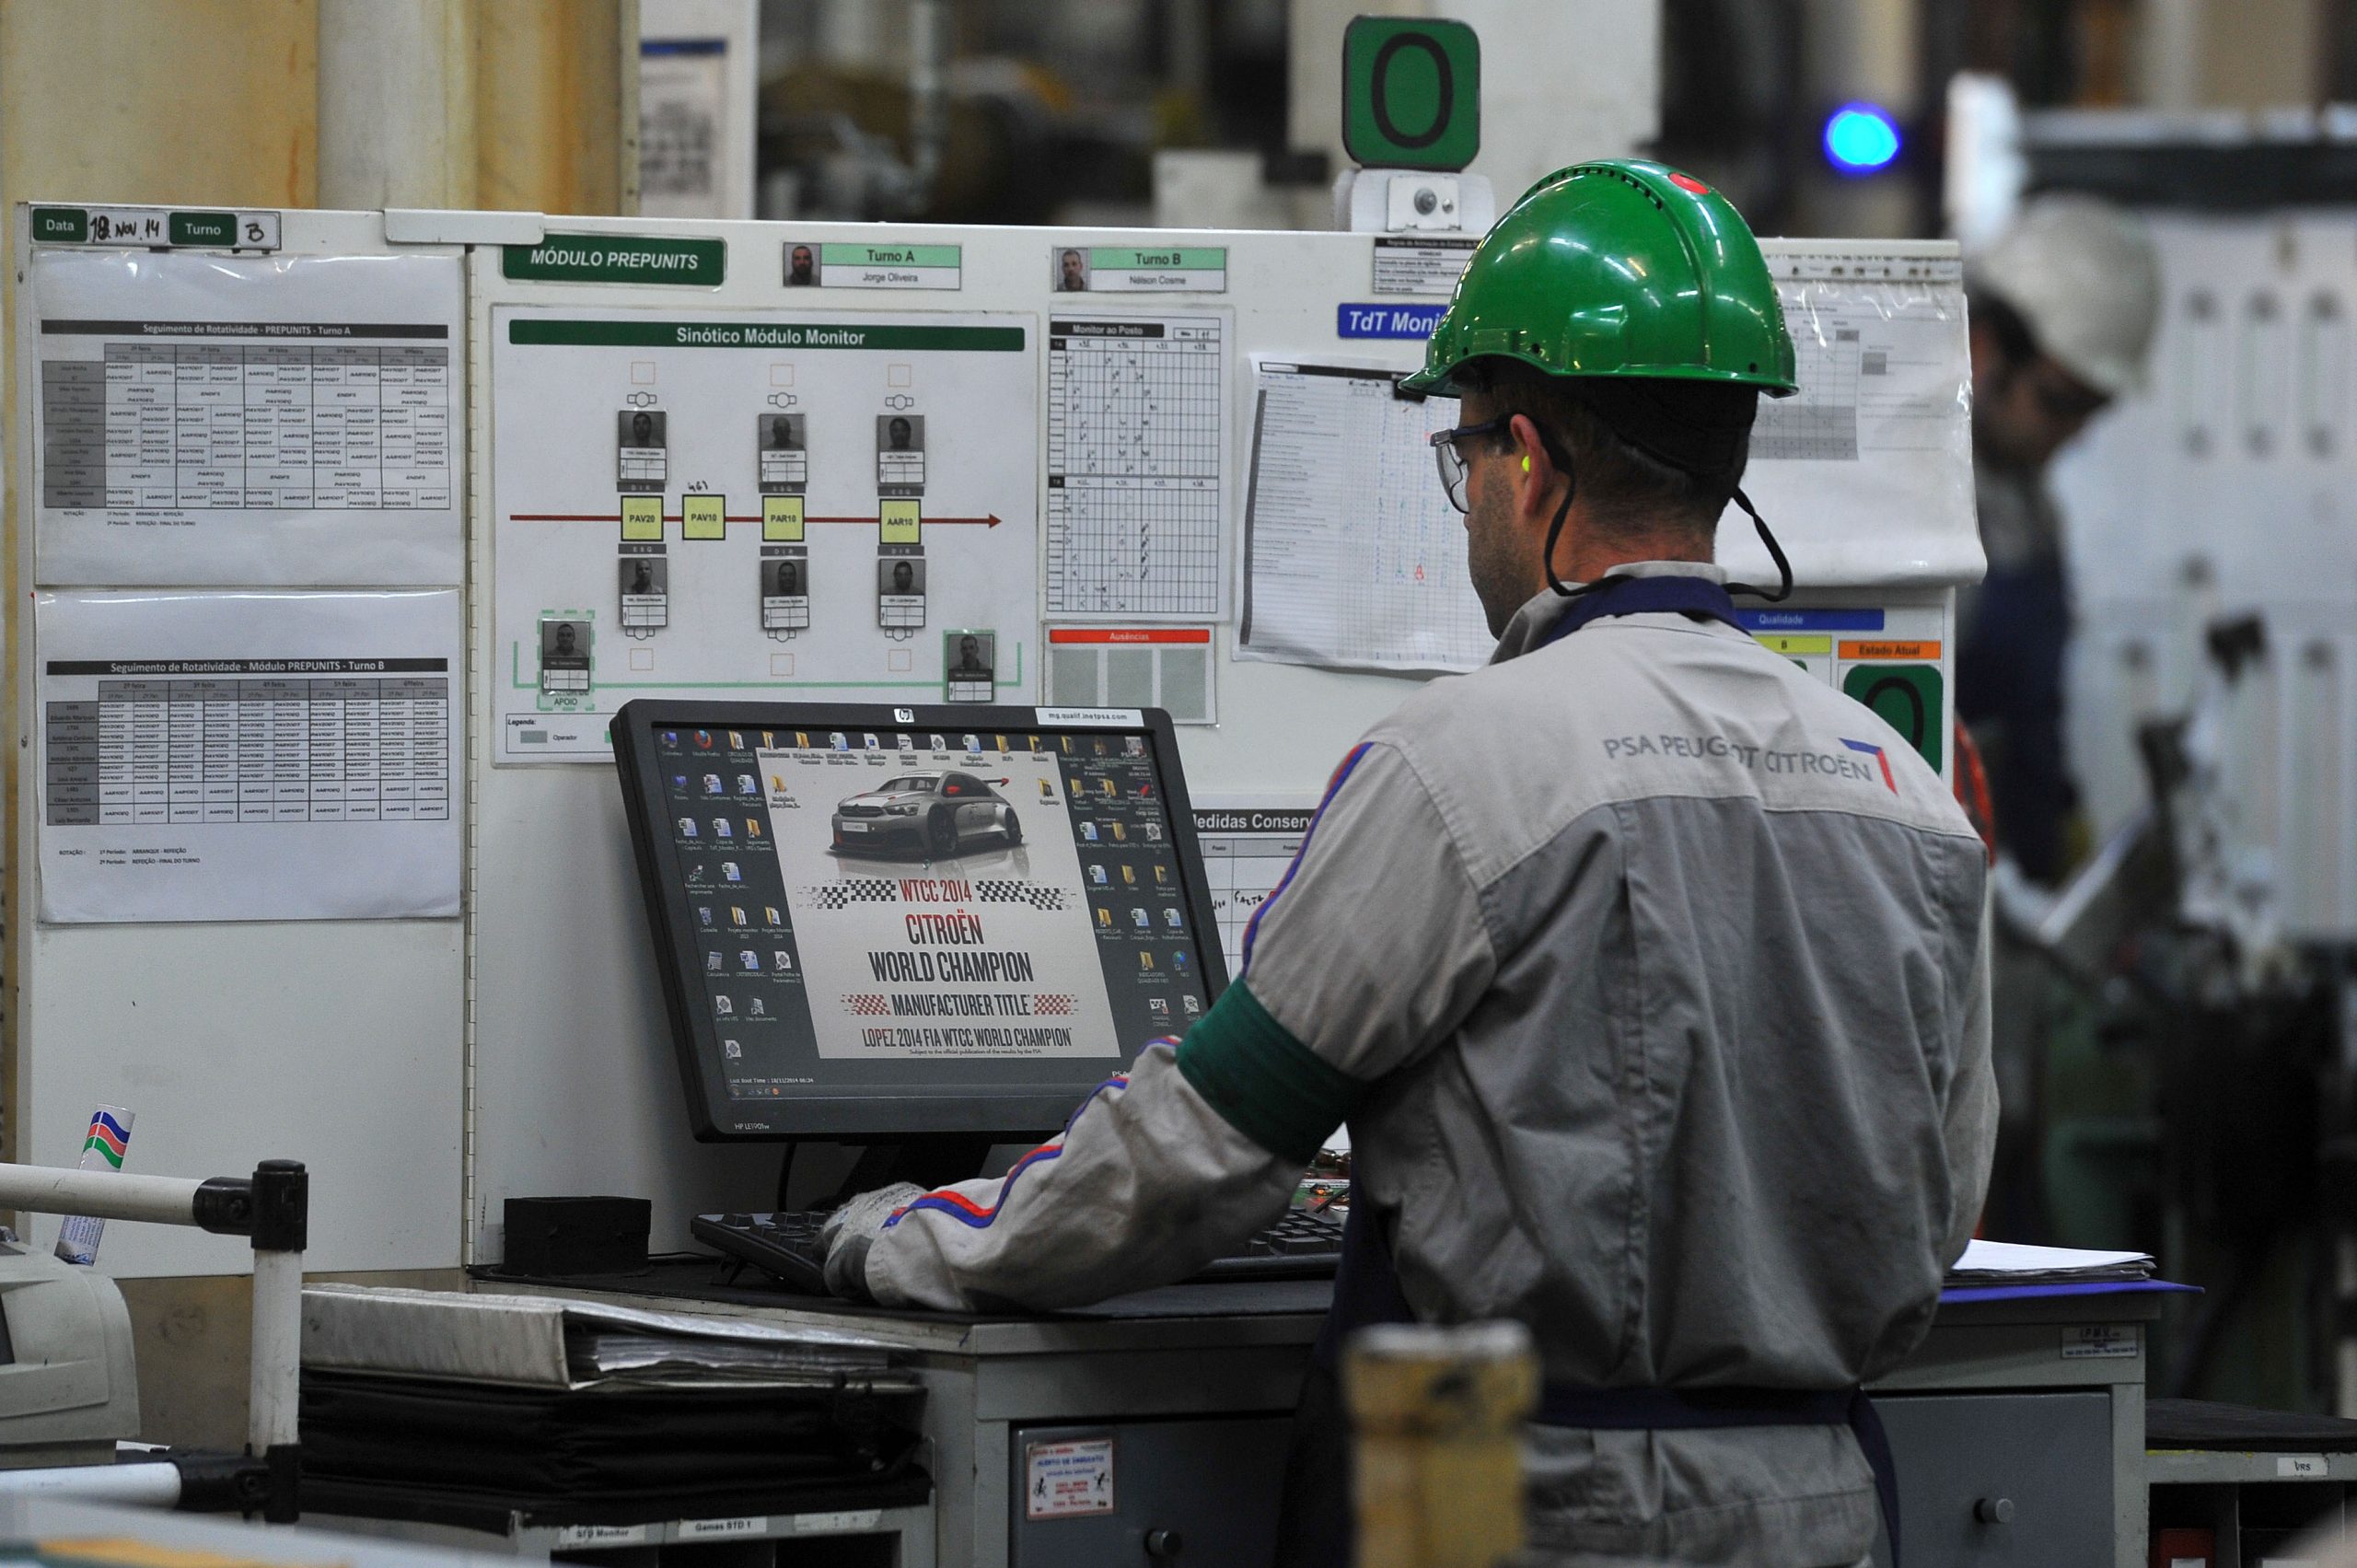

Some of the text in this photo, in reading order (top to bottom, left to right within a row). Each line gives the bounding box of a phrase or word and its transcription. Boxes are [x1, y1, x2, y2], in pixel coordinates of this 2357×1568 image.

[45, 217, 75, 232] Data
[145, 217, 160, 238] 14
[185, 222, 222, 237] Turno
[530, 246, 699, 271] MÓDULO PREPUNITS
[866, 249, 915, 263] Turno A
[1135, 253, 1181, 266] Turno B
[862, 273, 918, 284] Jorge Oliveira
[1158, 275, 1187, 286] Cosme
[1349, 310, 1439, 332] TdT Moni
[143, 323, 352, 335] Seguimento de Rotatividade PREPUNITS Turno A
[1073, 325, 1105, 335] Monitor
[1120, 326, 1144, 335] Posto
[676, 326, 865, 346] Sinótico Módulo Monitor
[629, 514, 656, 524] PAV20
[691, 513, 717, 523] PAV10
[770, 514, 796, 524] PAR10
[887, 517, 913, 527] AAR10
[1758, 613, 1804, 626] Qualidade
[1109, 632, 1149, 642] Ausências
[1859, 644, 1921, 656] Estado Atual
[110, 661, 385, 674] Seguimento de Rotatividade Módulo PREPUNITS Turno B
[553, 697, 578, 707] APOIO
[507, 718, 537, 727] Legenda:
[552, 733, 577, 742] Operador
[1602, 735, 1873, 782] PSA PEUGT CITROËN
[1191, 813, 1313, 829] edidas Conserv
[899, 879, 973, 902] WTCC 2014
[905, 910, 984, 945] CITROËN
[867, 951, 1034, 982] WORLD CHAMPION
[890, 993, 993, 1016] MANUFACTURER
[862, 1028, 896, 1048] LOPEZ
[897, 1028, 923, 1047] 2014
[924, 1028, 942, 1047] FIA
[942, 1028, 973, 1047] WTCC
[973, 1028, 1013, 1047] WORLD
